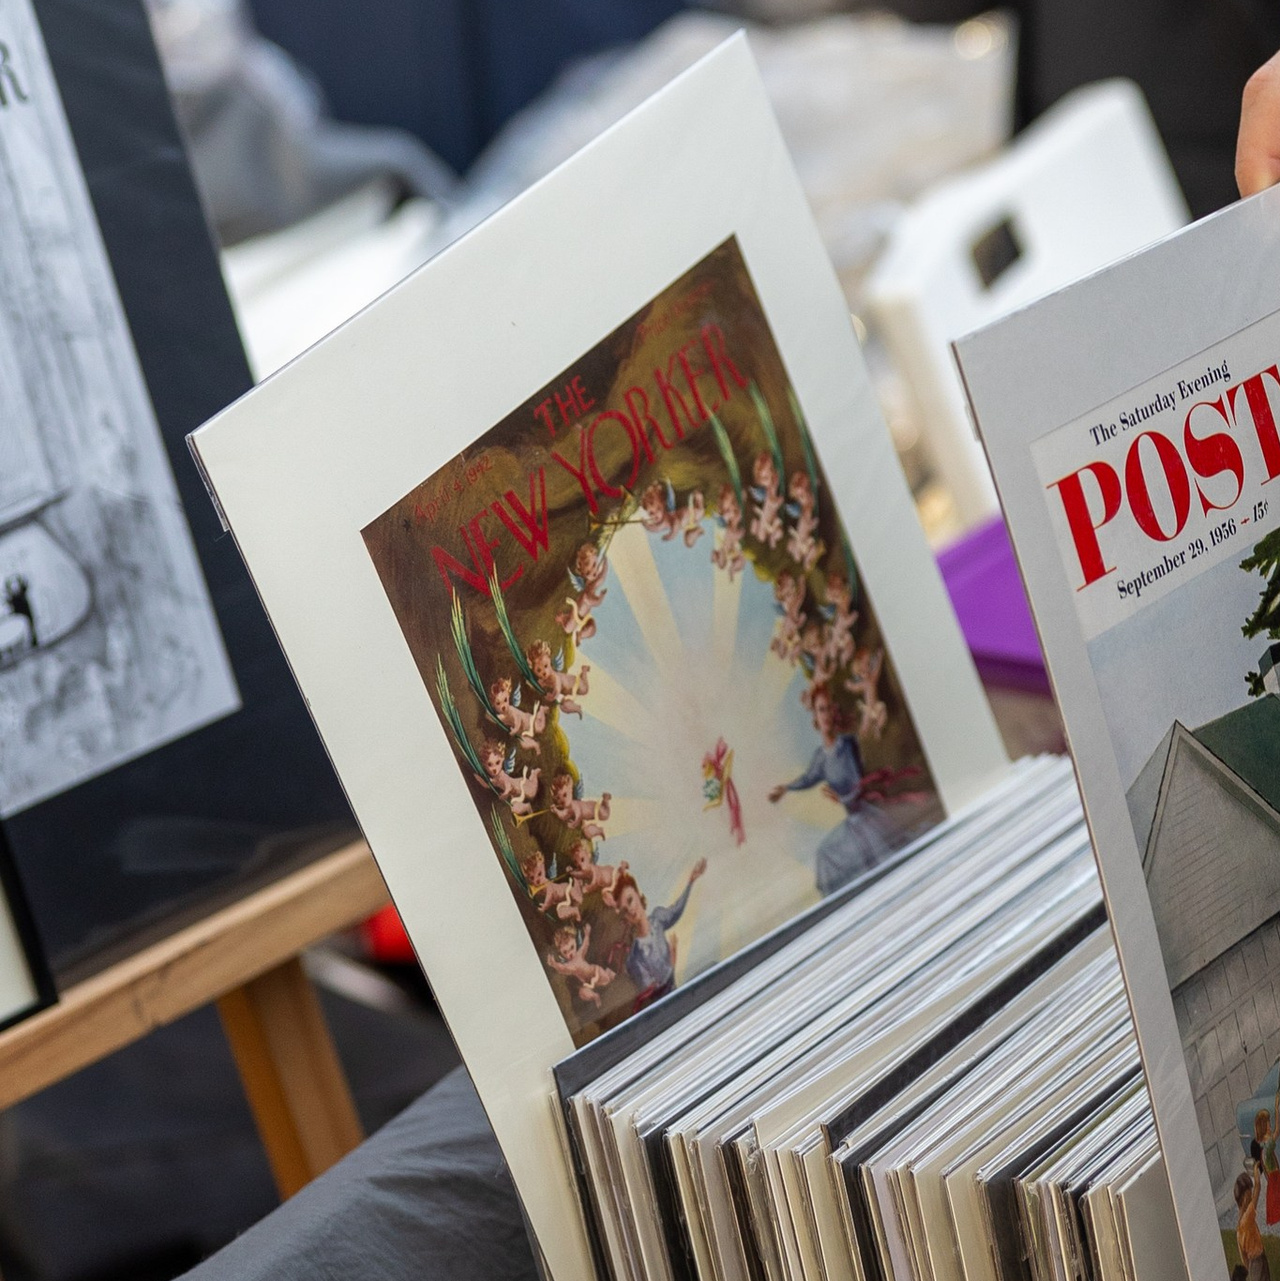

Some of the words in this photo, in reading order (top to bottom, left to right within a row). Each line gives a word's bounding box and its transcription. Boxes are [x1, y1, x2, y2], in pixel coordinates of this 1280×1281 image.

[533, 375, 596, 438] THE
[1089, 422, 1118, 447] The
[1118, 391, 1176, 431] Saturday
[1177, 360, 1231, 402] Evening
[414, 481, 452, 526] April
[465, 455, 493, 487] 1942
[430, 466, 550, 599] NEW
[550, 323, 750, 516] YORKER
[1116, 548, 1187, 600] September
[1188, 538, 1209, 560] 29,
[1209, 518, 1237, 547] 1956
[1253, 498, 1269, 523] 15¢
